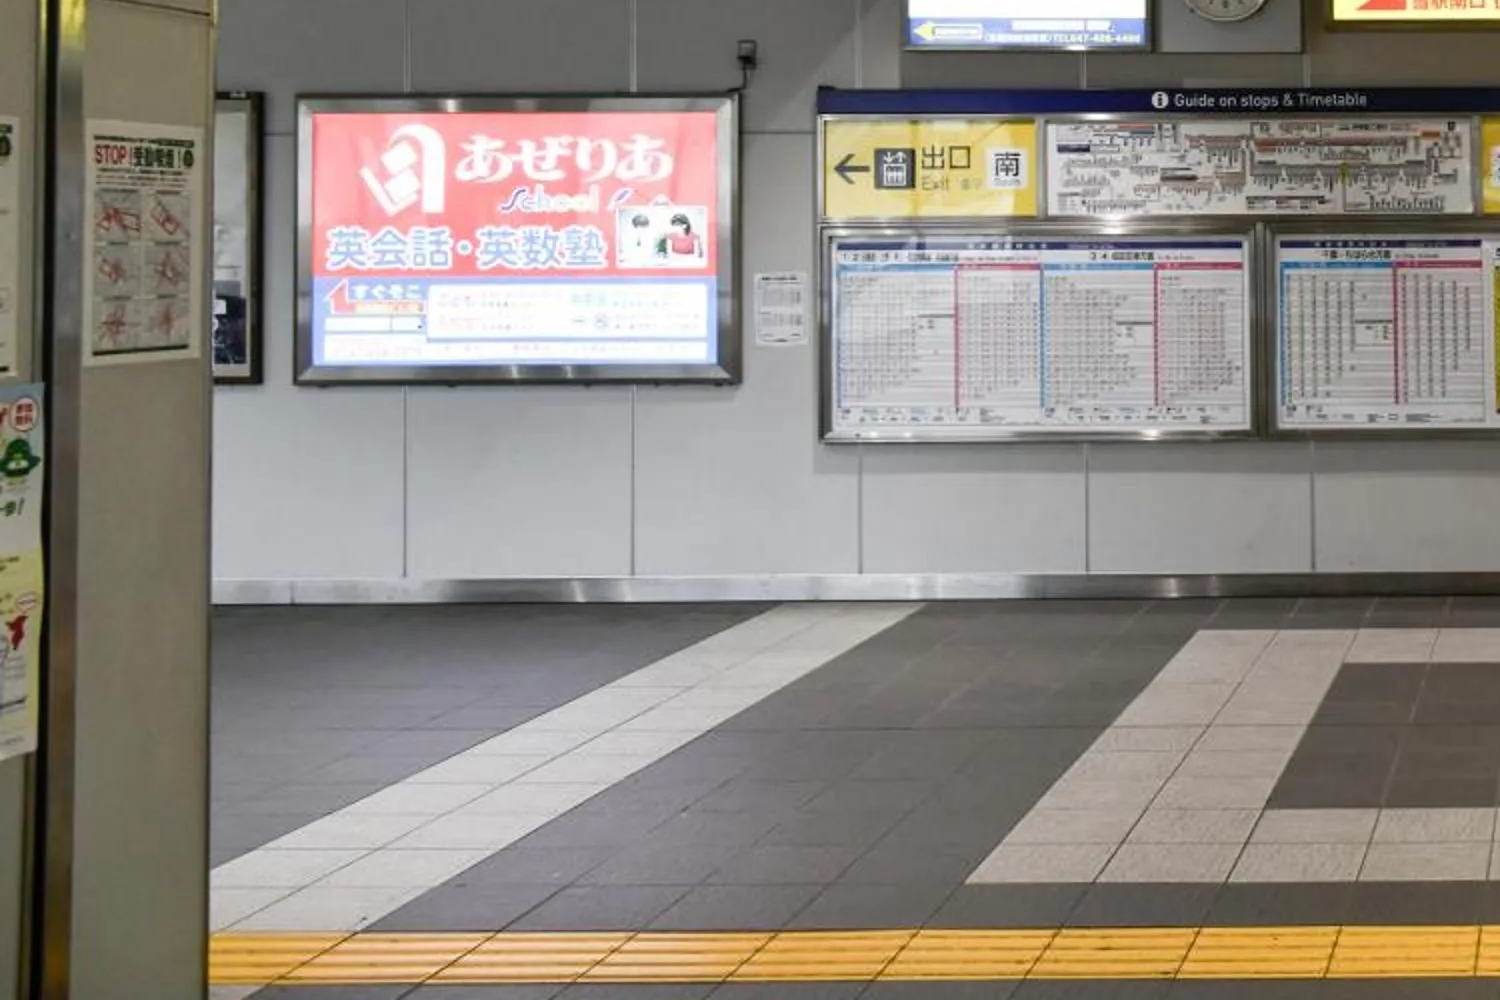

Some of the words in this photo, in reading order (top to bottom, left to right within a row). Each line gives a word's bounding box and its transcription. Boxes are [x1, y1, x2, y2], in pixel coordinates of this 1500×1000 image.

[1174, 93, 1215, 107] Guide
[1219, 96, 1236, 107] on
[1298, 92, 1367, 107] Timetable
[455, 132, 674, 184] あぜりあ
[921, 144, 971, 169] 出口
[993, 151, 1023, 177] 南
[328, 227, 606, 269] 英会話・英数塾
